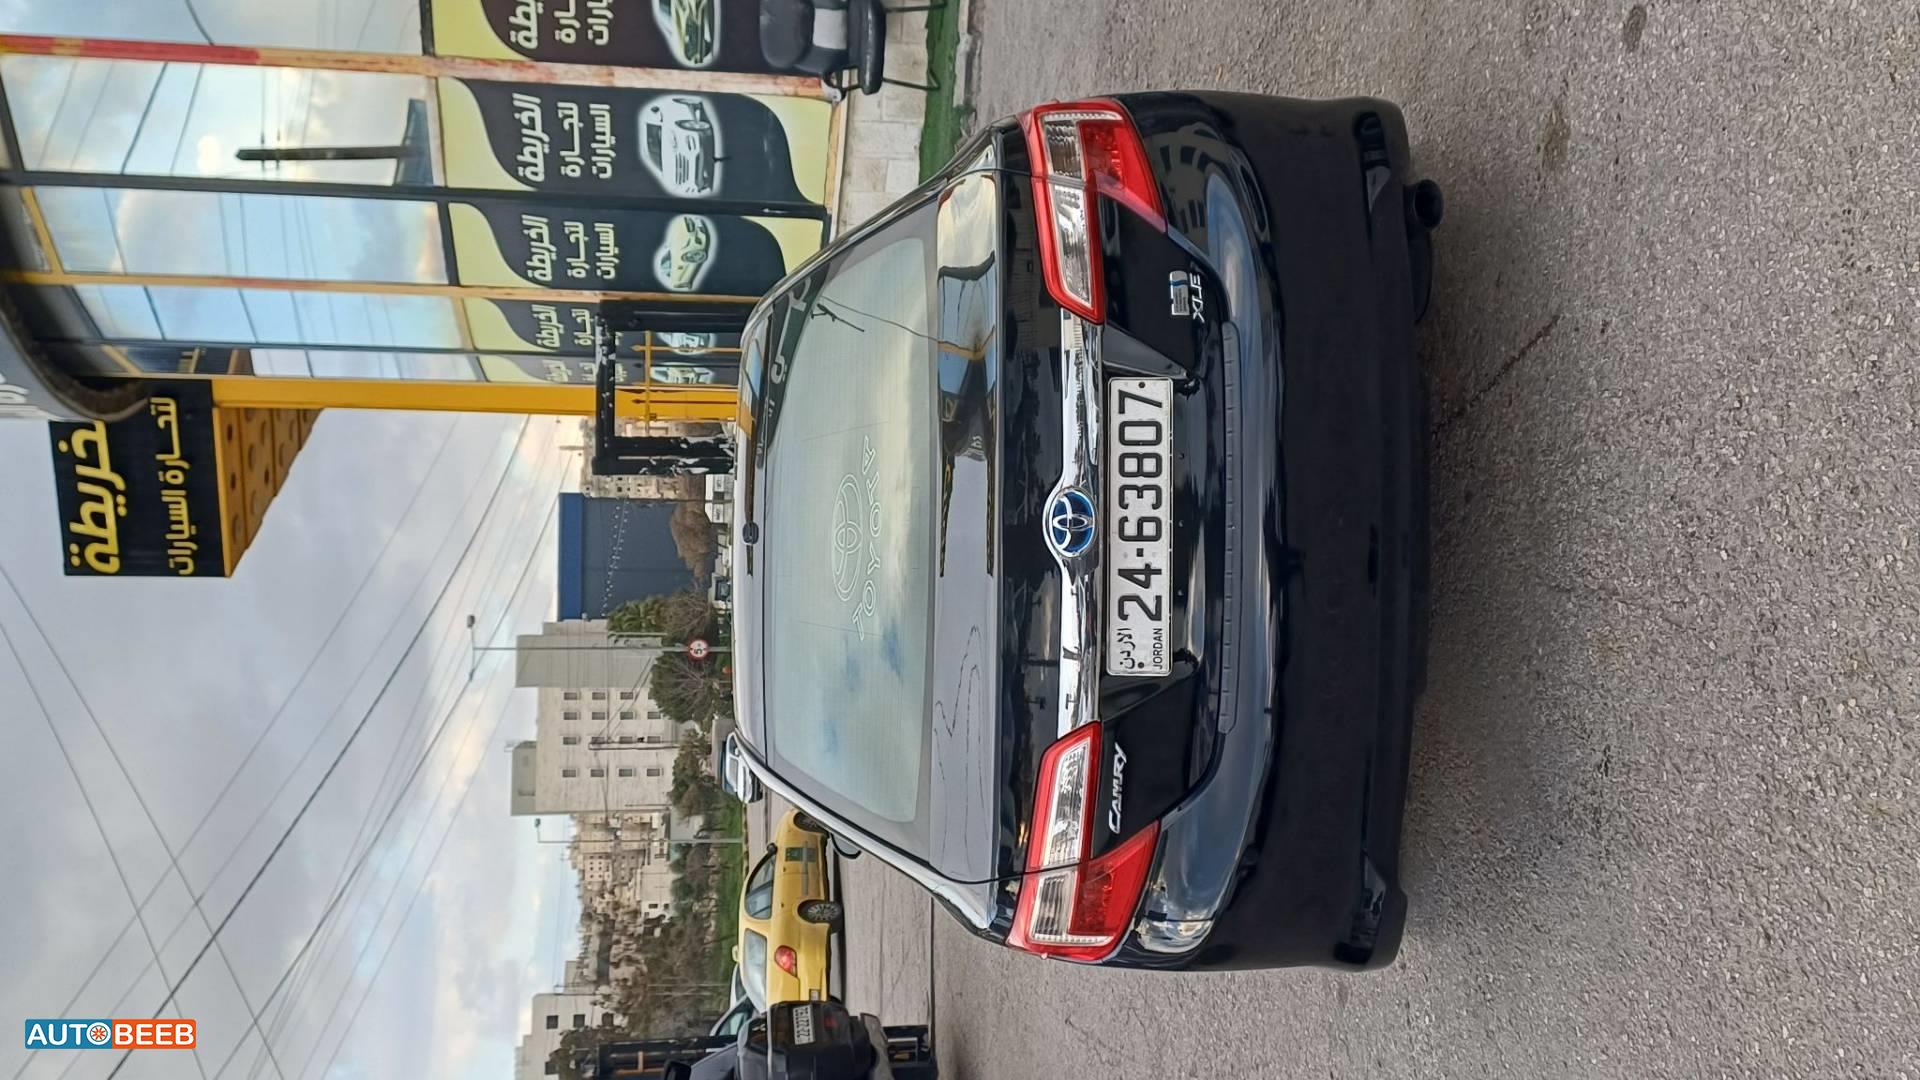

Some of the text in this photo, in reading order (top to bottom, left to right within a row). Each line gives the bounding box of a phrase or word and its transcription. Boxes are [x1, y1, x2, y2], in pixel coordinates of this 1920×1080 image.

[512, 93, 550, 182] الخريطة
[557, 102, 585, 178] لتجارة
[589, 104, 616, 179] السيارات
[521, 214, 557, 281] الخريطة
[563, 220, 591, 278] لتجارة
[594, 222, 620, 279] السيارات
[531, 304, 565, 347] الخريطة
[570, 308, 595, 346] لتجارة
[1189, 272, 1204, 323] XLE
[57, 420, 127, 574] خريطة
[160, 489, 198, 575] السيارات
[1117, 389, 1163, 622] 24-63807
[852, 435, 882, 641] TOYOTA
[1153, 628, 1163, 670] JORDAN
[1108, 742, 1127, 834] CAMRY
